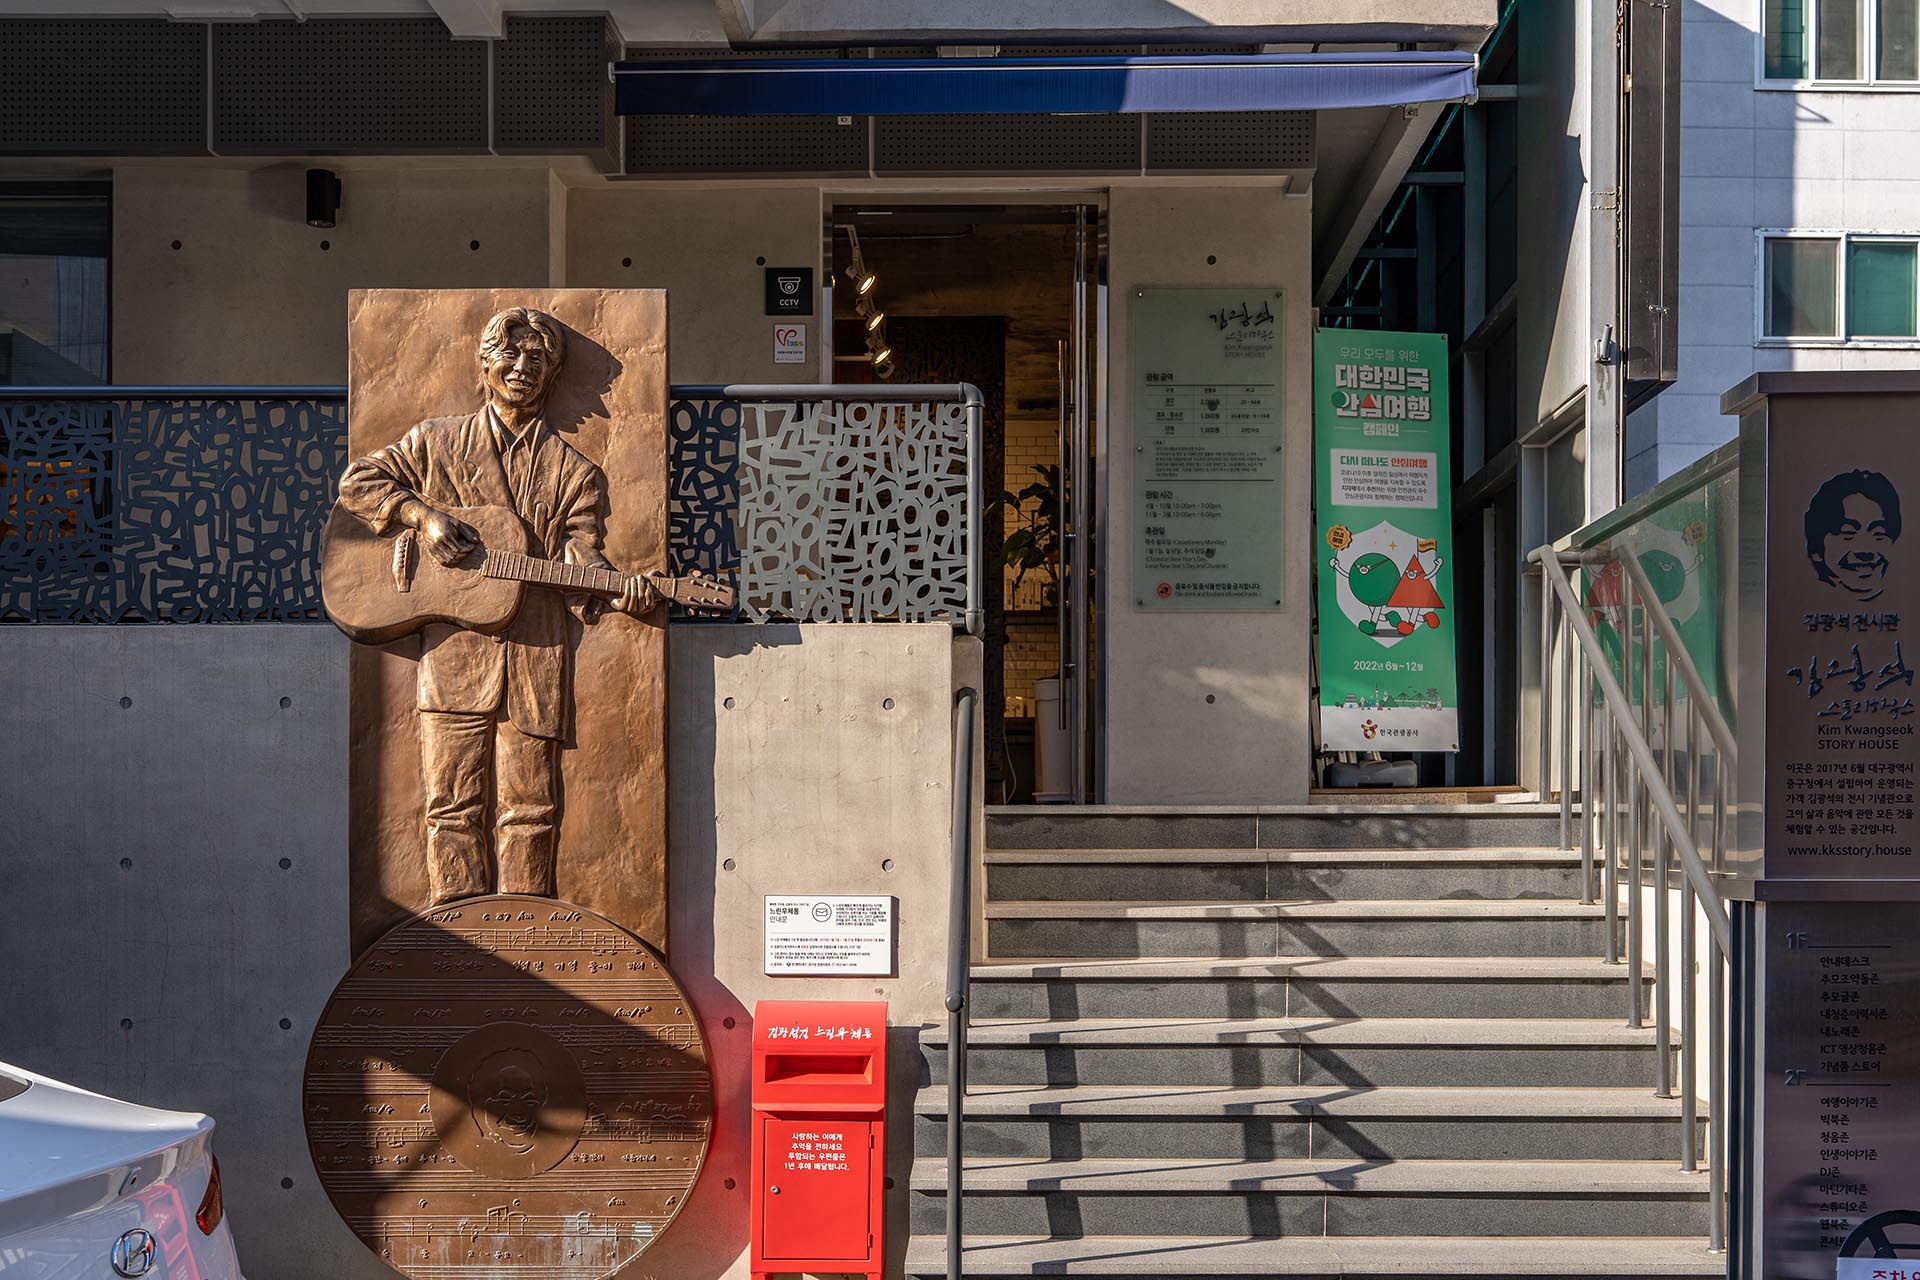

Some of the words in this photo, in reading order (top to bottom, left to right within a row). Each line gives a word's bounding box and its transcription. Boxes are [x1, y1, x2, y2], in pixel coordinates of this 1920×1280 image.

[1339, 347, 1360, 359] 우리
[1364, 348, 1395, 362] 모두를
[1398, 350, 1420, 363] 위한
[1335, 365, 1430, 392] 대한민국
[1331, 391, 1431, 420] 안심여행
[1363, 422, 1400, 437] 캠페인
[1340, 455, 1359, 466] 다시
[1361, 457, 1389, 467] 떠나도
[1391, 458, 1428, 469] 안심여행
[1146, 526, 1165, 535] 휴관일
[1804, 612, 1850, 632] 김광석
[1853, 612, 1900, 632] 전시관
[1353, 660, 1384, 671] 2022년
[1379, 729, 1419, 737] 한국관광공사
[1818, 725, 1841, 735] Kim
[1845, 724, 1914, 738] Kwangseok
[1818, 739, 1855, 750] STORY
[1858, 739, 1900, 750] HOUSE
[1786, 763, 1813, 774] 이곳은
[1816, 763, 1848, 774] 2017년
[1850, 763, 1865, 774] 6월
[1868, 763, 1913, 774] 대구광역시
[1786, 779, 1833, 789] 중구청에서
[1836, 779, 1873, 789] 설립하여
[1877, 779, 1914, 789] 운영되는
[1786, 794, 1805, 804] 가객
[1808, 794, 1844, 804] 김광석의
[1847, 794, 1865, 804] 전시
[1868, 794, 1914, 804] 기념관으로
[1806, 809, 1824, 820] 삶과
[1826, 809, 1852, 820] 음악에
[1856, 809, 1873, 820] 관한
[1876, 809, 1893, 820] 모든
[1896, 809, 1913, 820] 것을
[1786, 824, 1813, 835] 체험할
[1816, 825, 1825, 835] 수
[1828, 824, 1846, 835] 있는
[1850, 824, 1897, 835] 공간입니다.
[1788, 844, 1912, 858] www.kksstory.house
[769, 907, 799, 915] 느린우체통
[769, 916, 788, 924] 안내문
[1786, 931, 1808, 949] 1F
[1820, 956, 1870, 967] 안내데스크
[1821, 973, 1880, 985] 추모조약돌존
[1821, 991, 1860, 1003] 추모글존
[1820, 1009, 1888, 1021] 내청춘이력서존
[767, 1026, 809, 1040] 김광석길
[1820, 1026, 1860, 1038] 내노래존
[1820, 1045, 1836, 1054] ICT
[1820, 1061, 1850, 1073] 기념품
[1852, 1061, 1881, 1072] 스토어
[1784, 1069, 1808, 1086] 2F
[1820, 1097, 1879, 1108] 여행이야기존
[1820, 1114, 1850, 1126] 빅북존
[791, 1132, 819, 1141] 사랑하는
[822, 1132, 843, 1141] 이에게
[1820, 1132, 1849, 1143] 청음존
[791, 1142, 812, 1151] 추억을
[815, 1142, 843, 1151] 전하세요
[787, 1152, 816, 1161] 투함되는
[818, 1152, 846, 1161] 우편물은
[1820, 1149, 1878, 1161] 인생이야기존
[784, 1162, 795, 1171] 1년
[797, 1162, 811, 1171] 후에
[813, 1161, 850, 1171] 배달됩니다.
[1819, 1167, 1841, 1178] DJ존
[1819, 1184, 1868, 1195] 마틴기타존
[1819, 1202, 1868, 1213] 스튜디오존
